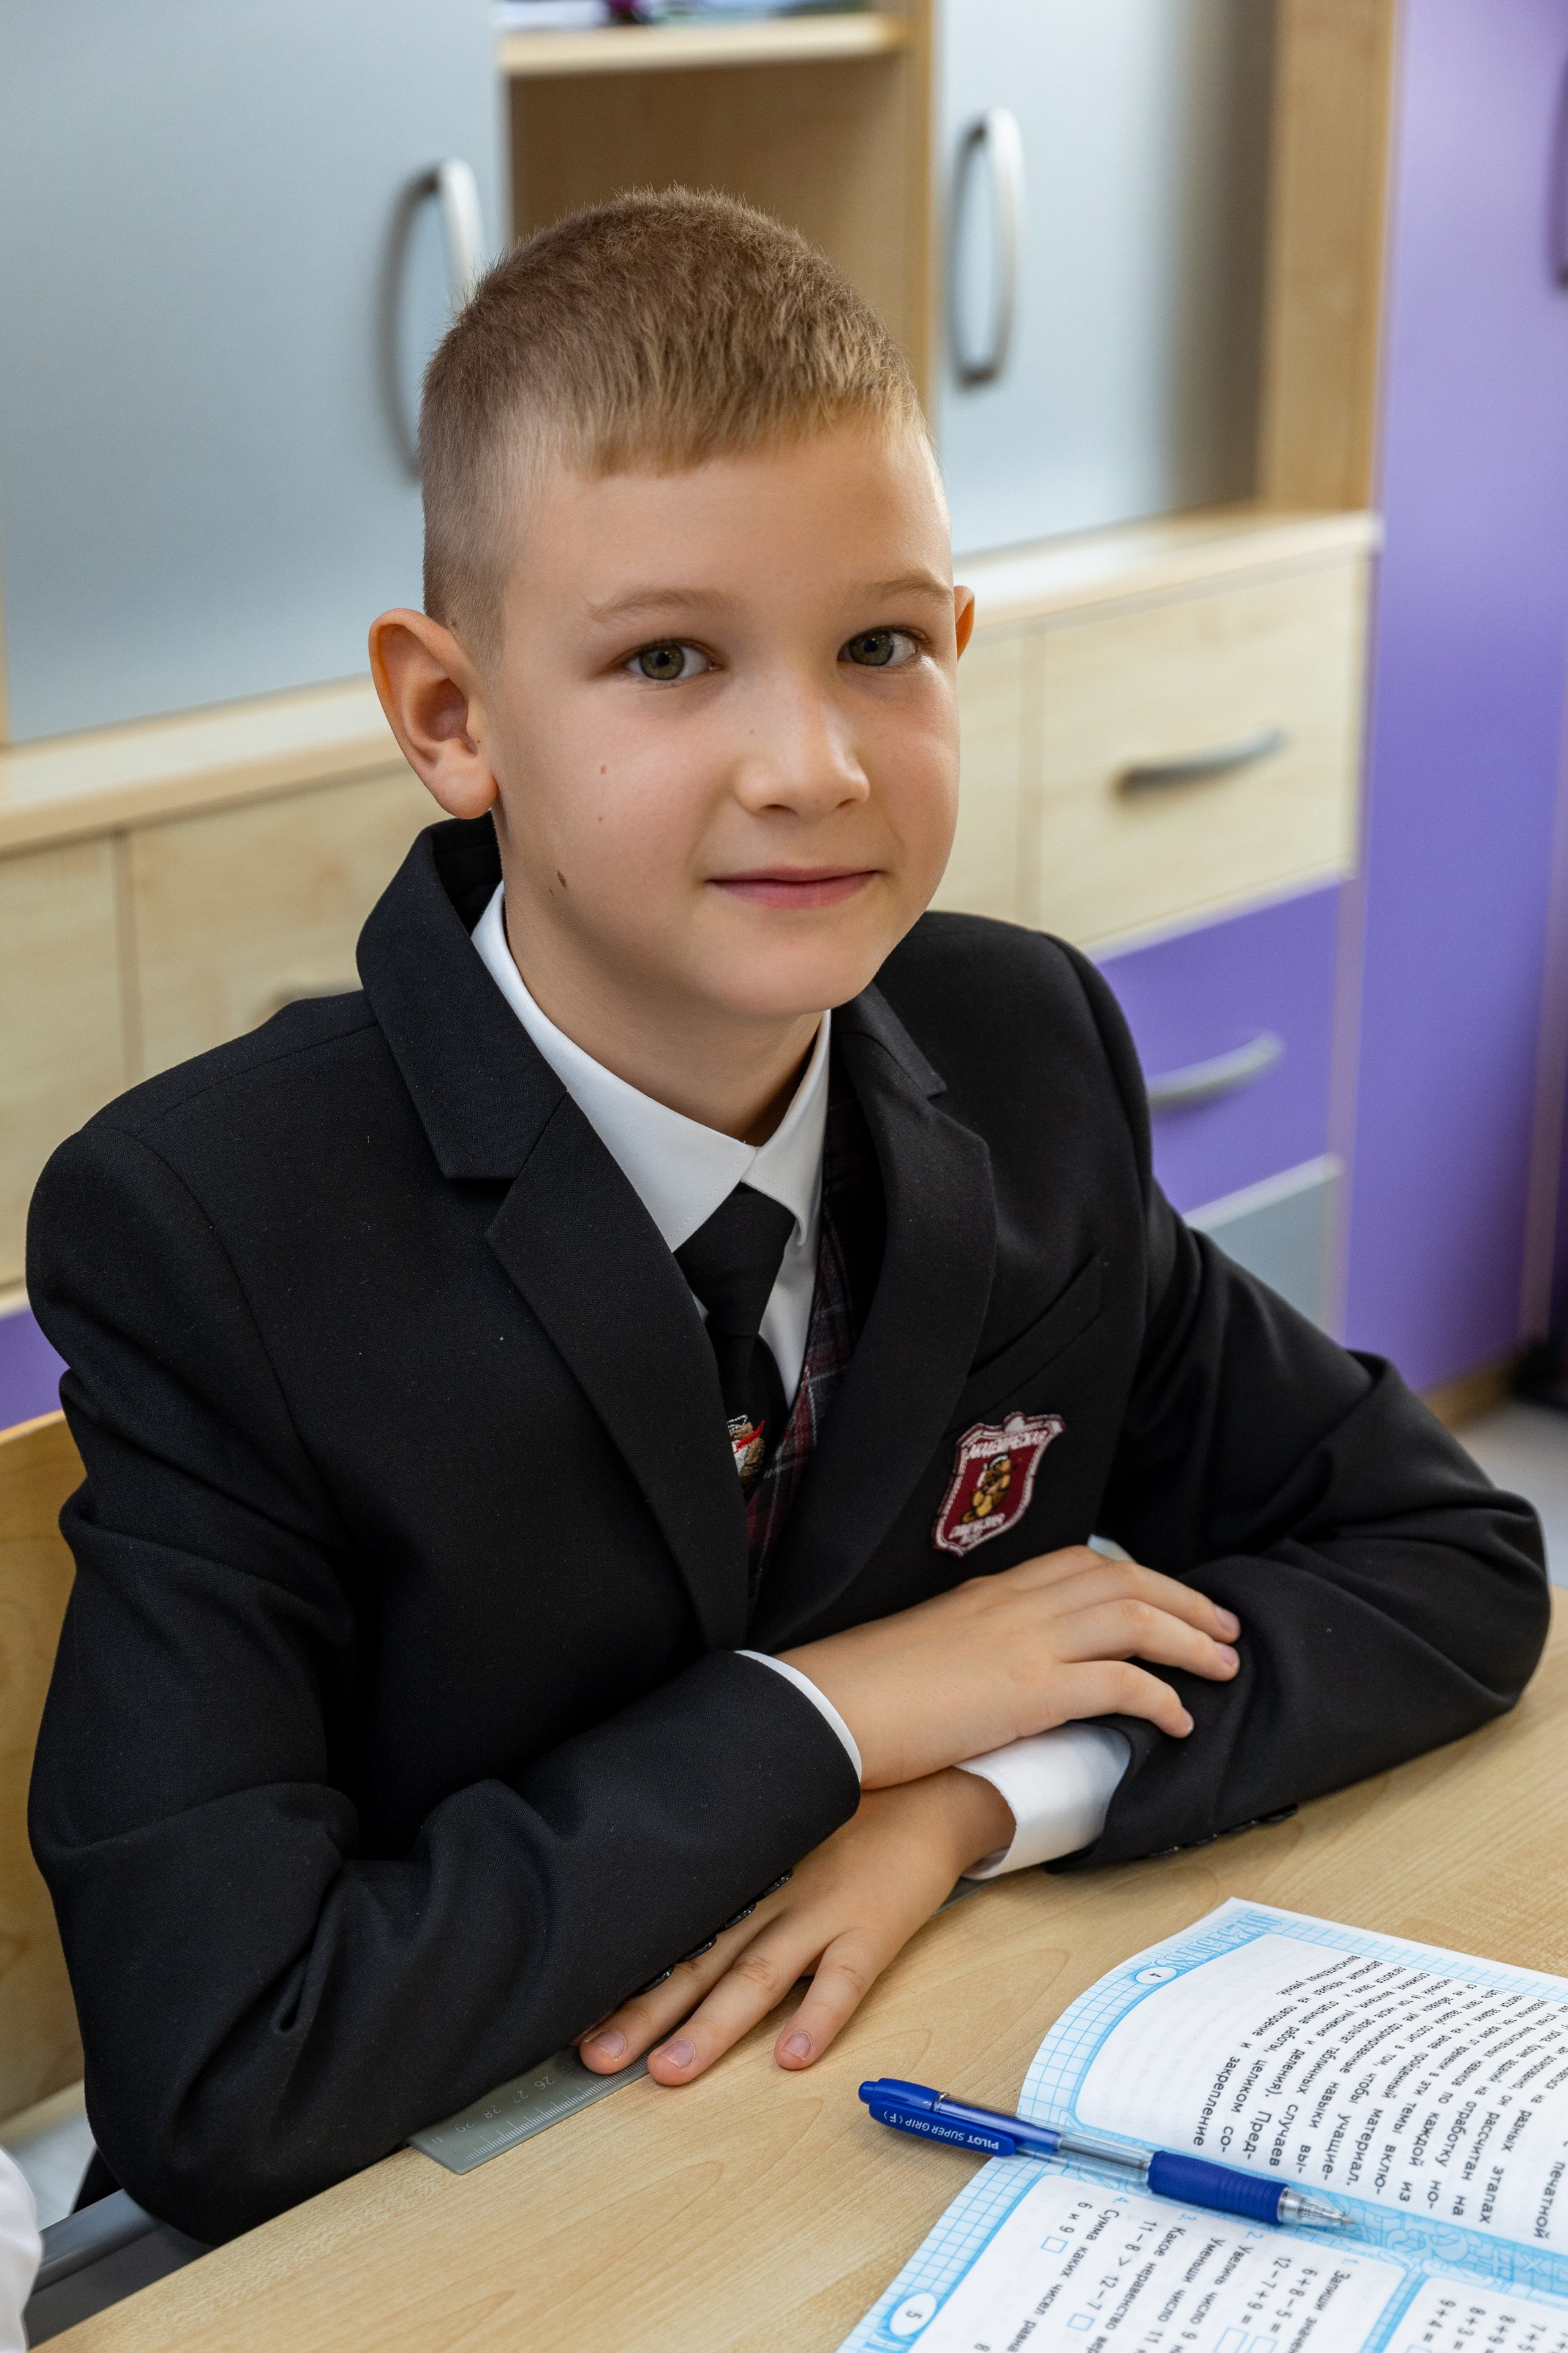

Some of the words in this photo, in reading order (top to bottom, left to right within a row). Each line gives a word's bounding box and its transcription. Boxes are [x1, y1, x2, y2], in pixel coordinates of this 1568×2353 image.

[535, 2076, 555, 2090] 26
[1231, 2060, 1267, 2113] целиком
[1381, 2052, 1429, 2099] пройденный
[1451, 2060, 1484, 2086] навыков
[1487, 2060, 1518, 2083] заданий
[513, 2090, 528, 2104] 27
[1193, 2057, 1240, 2146] закрепление
[1349, 2073, 1377, 2104] чтобы
[1413, 2080, 1431, 2096] эти
[1438, 2092, 1453, 2104] по
[1474, 2086, 1489, 2095] на
[1498, 2095, 1512, 2106] он
[1531, 2094, 1545, 2103] на
[1309, 2082, 1340, 2128] навыки
[1392, 2103, 1417, 2134] темы
[905, 2119, 930, 2132] GRIP
[931, 2128, 965, 2141] SUPER
[1269, 2104, 1298, 2167] случаев
[1409, 2112, 1440, 2166] каждой
[1435, 2101, 1477, 2167] отработку
[1501, 2110, 1532, 2152] разных
[967, 2134, 1000, 2150] PILOT
[1461, 2112, 1501, 2181] рассчитан
[1399, 2181, 1412, 2202] из
[1452, 2196, 1466, 2216] на
[1479, 2166, 1504, 2224] этапах
[1534, 2161, 1566, 2238] печатной
[1085, 2209, 1120, 2240] Сумма
[1154, 2227, 1187, 2256] Какое
[1060, 2246, 1088, 2278] каких
[1183, 2237, 1226, 2283] Уменьши
[1214, 2245, 1254, 2285] Увеличь
[1035, 2284, 1063, 2315] чисел
[1105, 2262, 1156, 2330] неравенство
[1158, 2289, 1186, 2322] число
[1314, 2270, 1351, 2311] Запиши
[905, 2310, 923, 2319] 5
[1189, 2292, 1218, 2325] число
[1006, 2320, 1037, 2352] равна
[1145, 2331, 1163, 2344] 11
